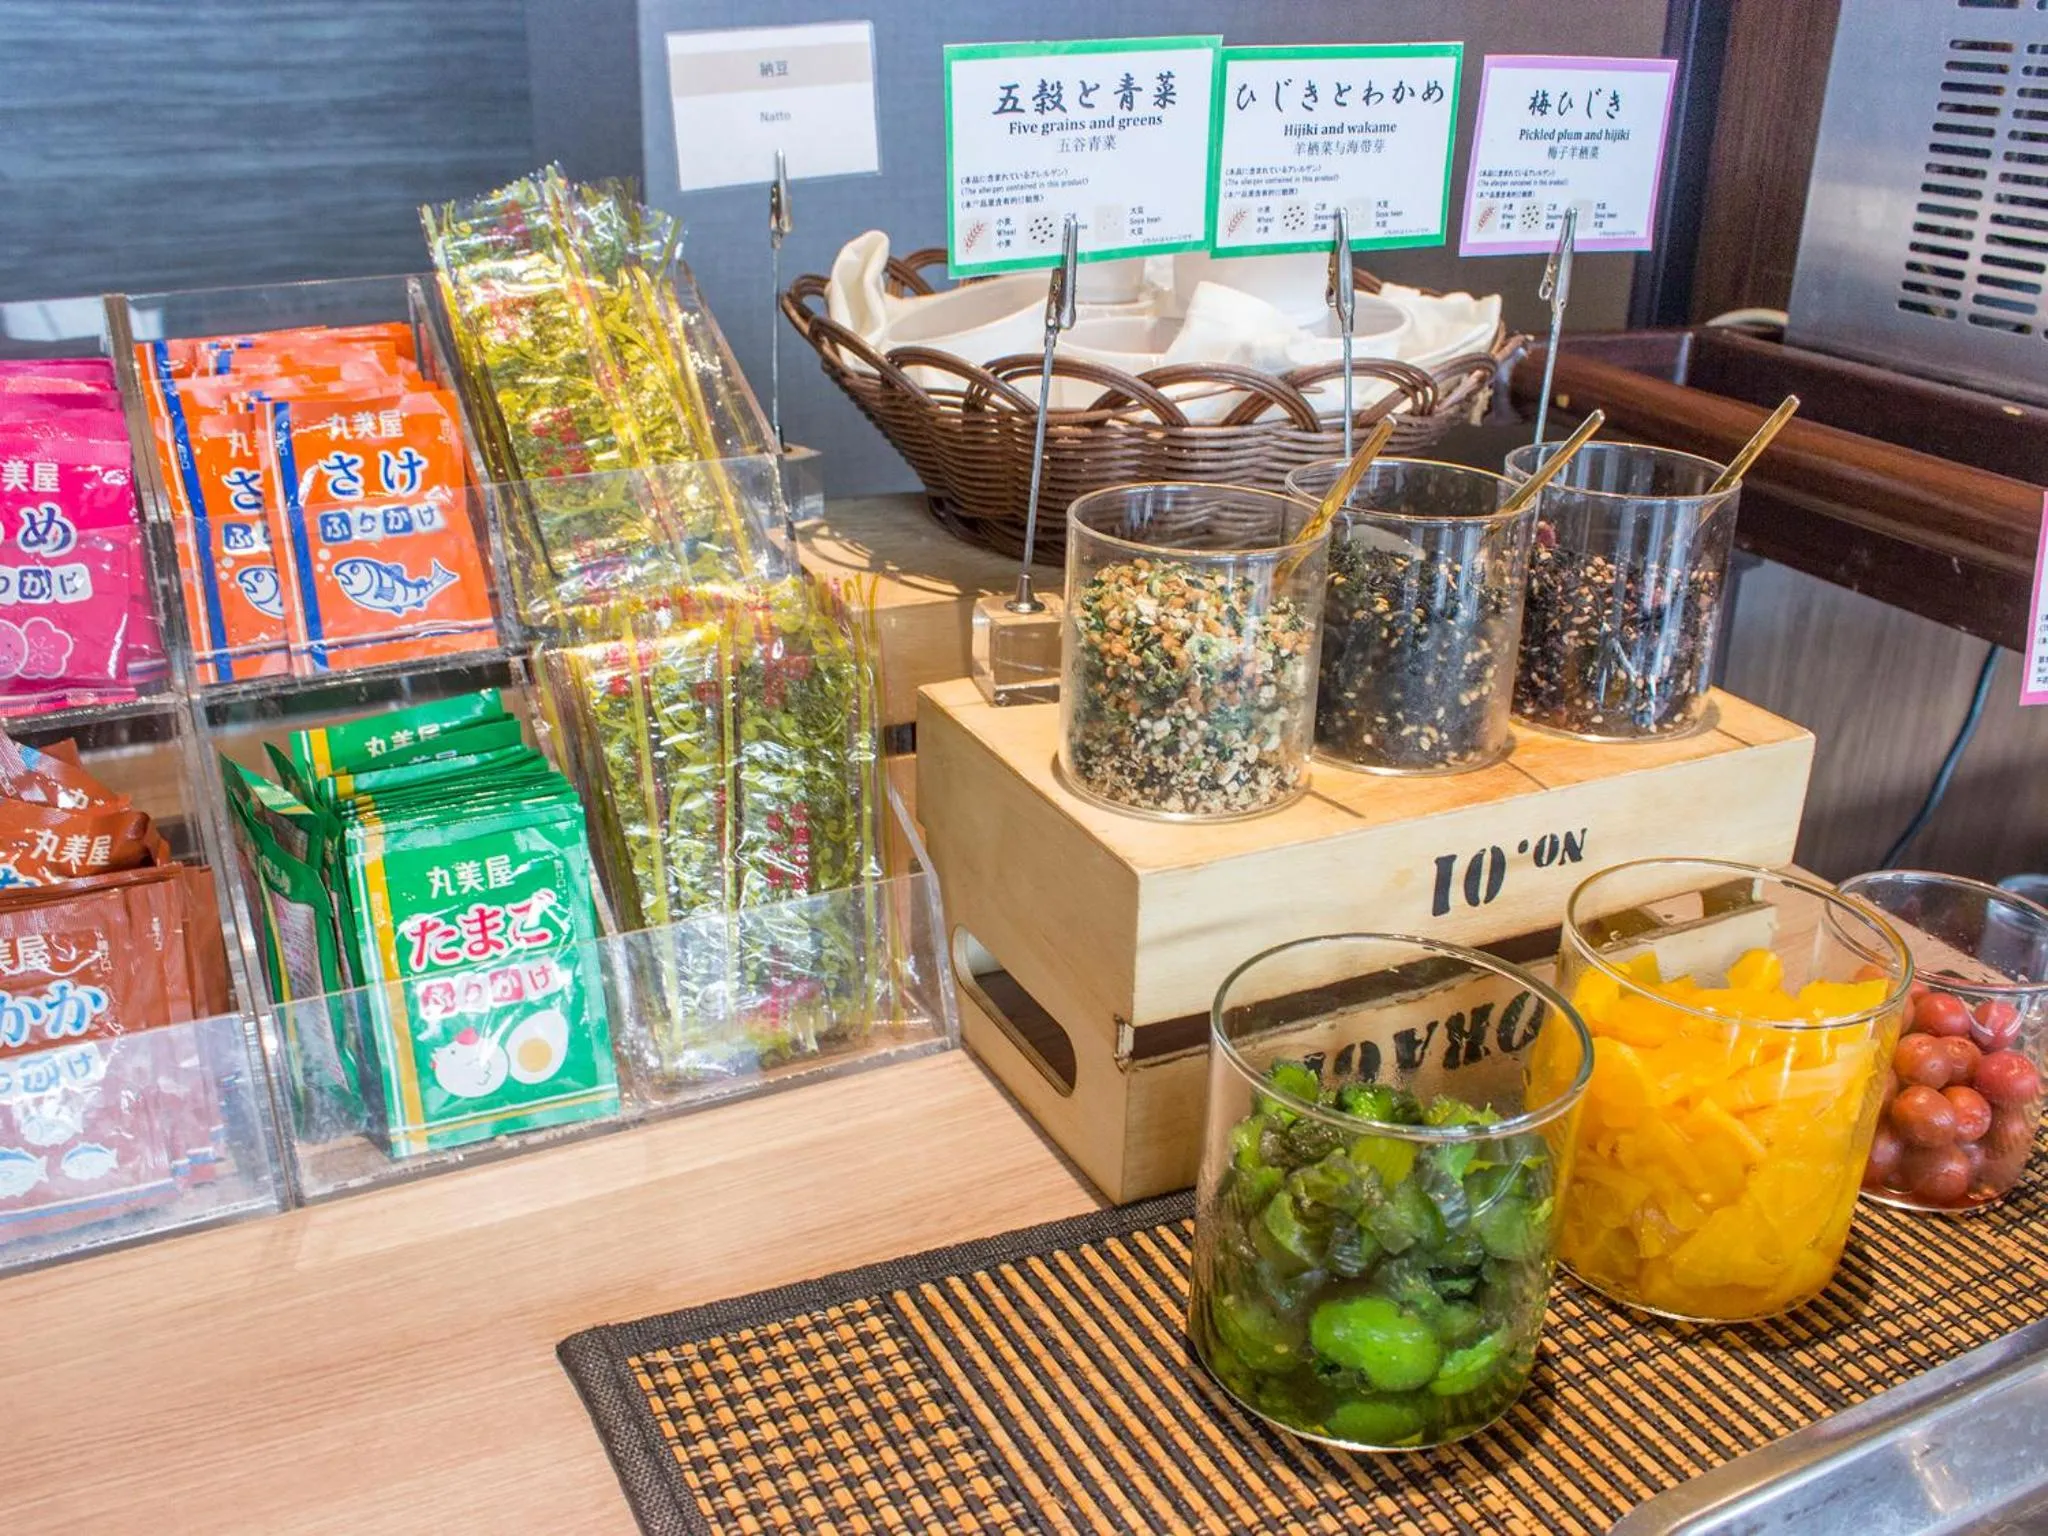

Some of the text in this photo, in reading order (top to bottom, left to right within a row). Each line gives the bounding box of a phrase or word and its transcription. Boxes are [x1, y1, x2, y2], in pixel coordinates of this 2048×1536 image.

[760, 60, 788, 78] 納豆
[992, 71, 1177, 115] 五穀と青菜
[1236, 78, 1444, 113] ひじきとわかめ
[1528, 88, 1621, 119] 梅ひじき
[760, 111, 791, 123] Natto
[1009, 113, 1163, 135] Five grains and greens
[1284, 121, 1397, 139] Hijiki and wakame
[1057, 134, 1117, 154] 五谷青菜
[1519, 128, 1630, 144] Pickled plum and hijiki
[327, 409, 404, 440] 丸美屋
[322, 449, 427, 498] さけ
[320, 506, 439, 542] ふりかけ
[30, 828, 112, 866] 丸美屋
[425, 854, 515, 899] 丸美屋
[406, 889, 554, 971] たまご
